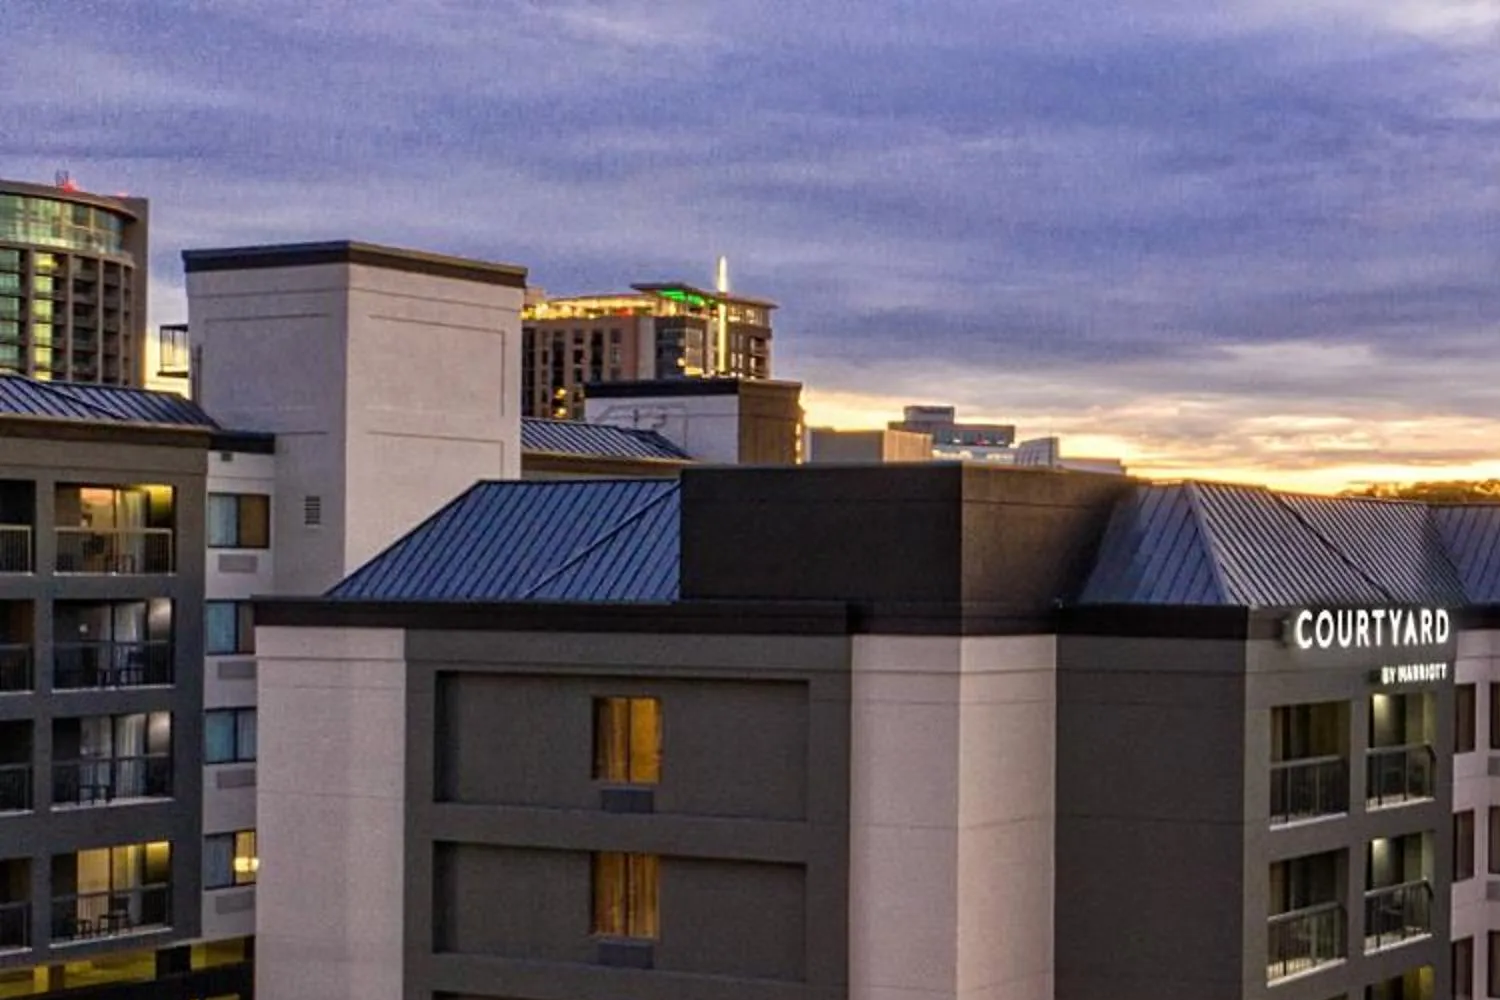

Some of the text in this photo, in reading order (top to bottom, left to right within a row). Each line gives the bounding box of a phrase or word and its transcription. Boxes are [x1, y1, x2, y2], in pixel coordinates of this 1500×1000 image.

[1295, 608, 1449, 649] COURTYARD
[1381, 662, 1448, 685] BY MARRIOTT
